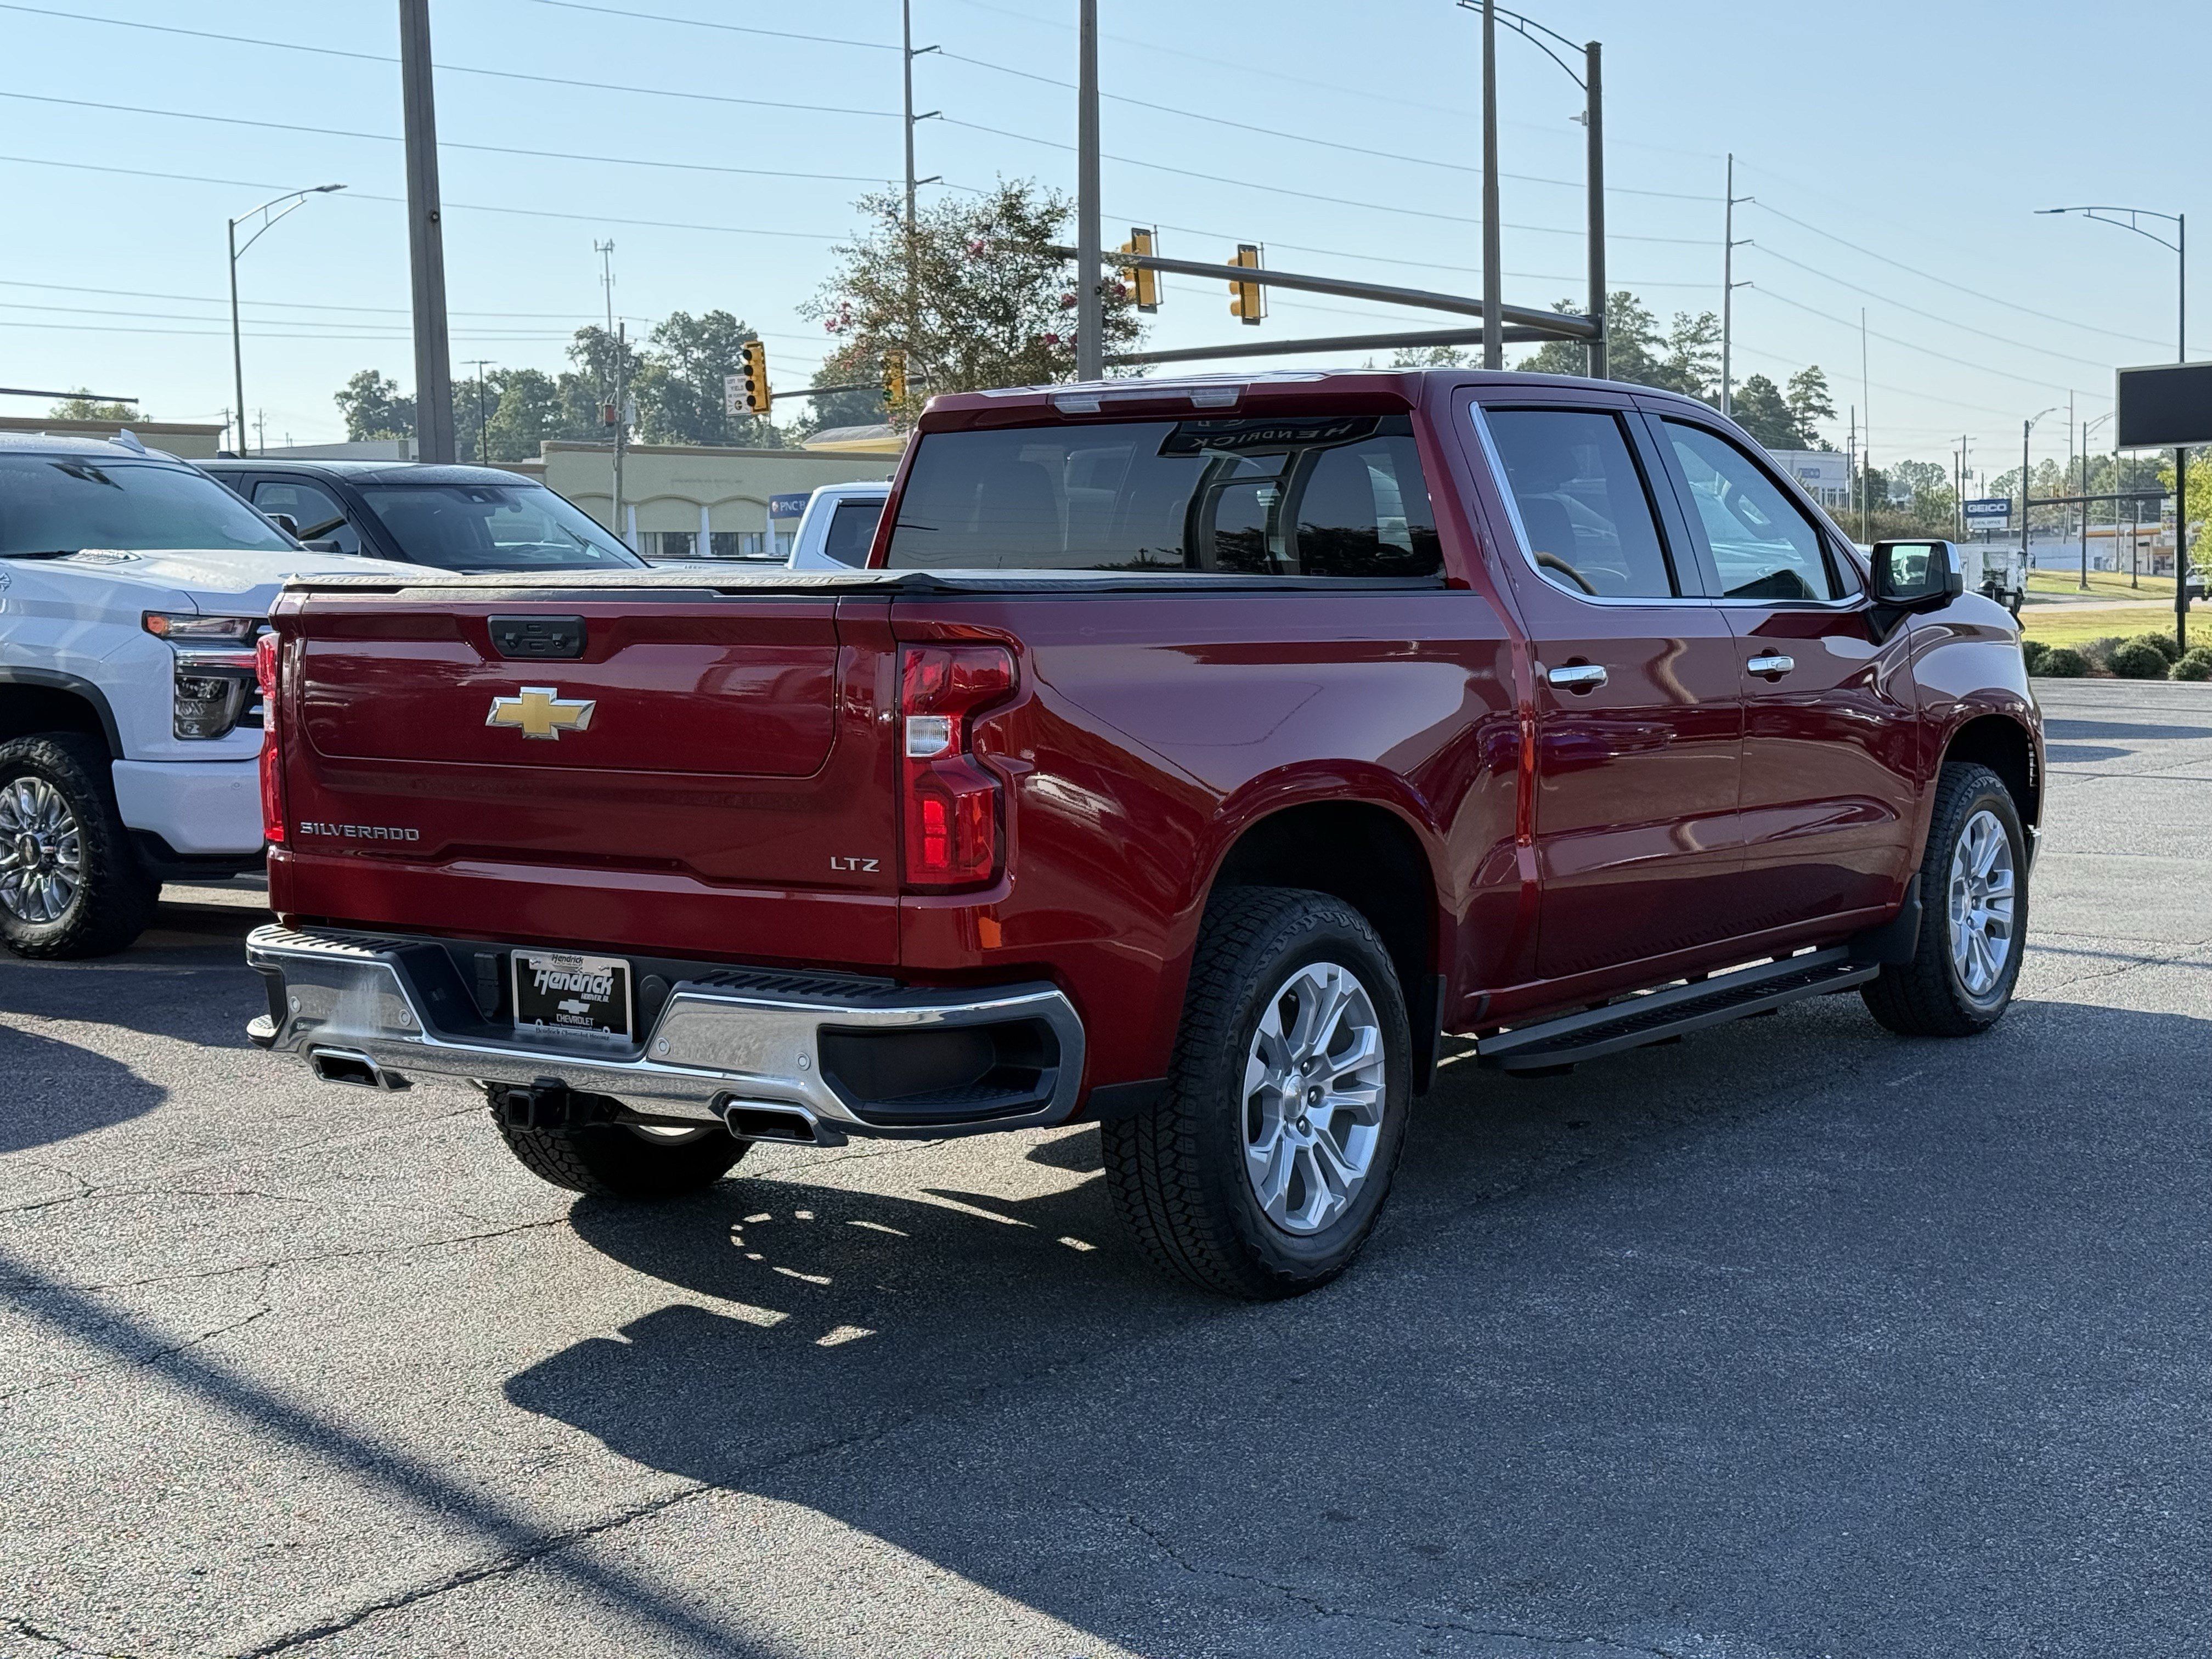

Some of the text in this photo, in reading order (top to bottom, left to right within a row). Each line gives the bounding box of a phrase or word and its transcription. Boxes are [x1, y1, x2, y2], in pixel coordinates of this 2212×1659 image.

[780, 500, 799, 511] PNC
[1967, 503, 2007, 513] GEICO
[300, 822, 420, 841] SILVERADO
[830, 856, 881, 872] LTZ
[551, 953, 584, 964] Hendrick
[534, 969, 614, 995] Hendrick
[556, 1013, 595, 1026] CHEVROLET
